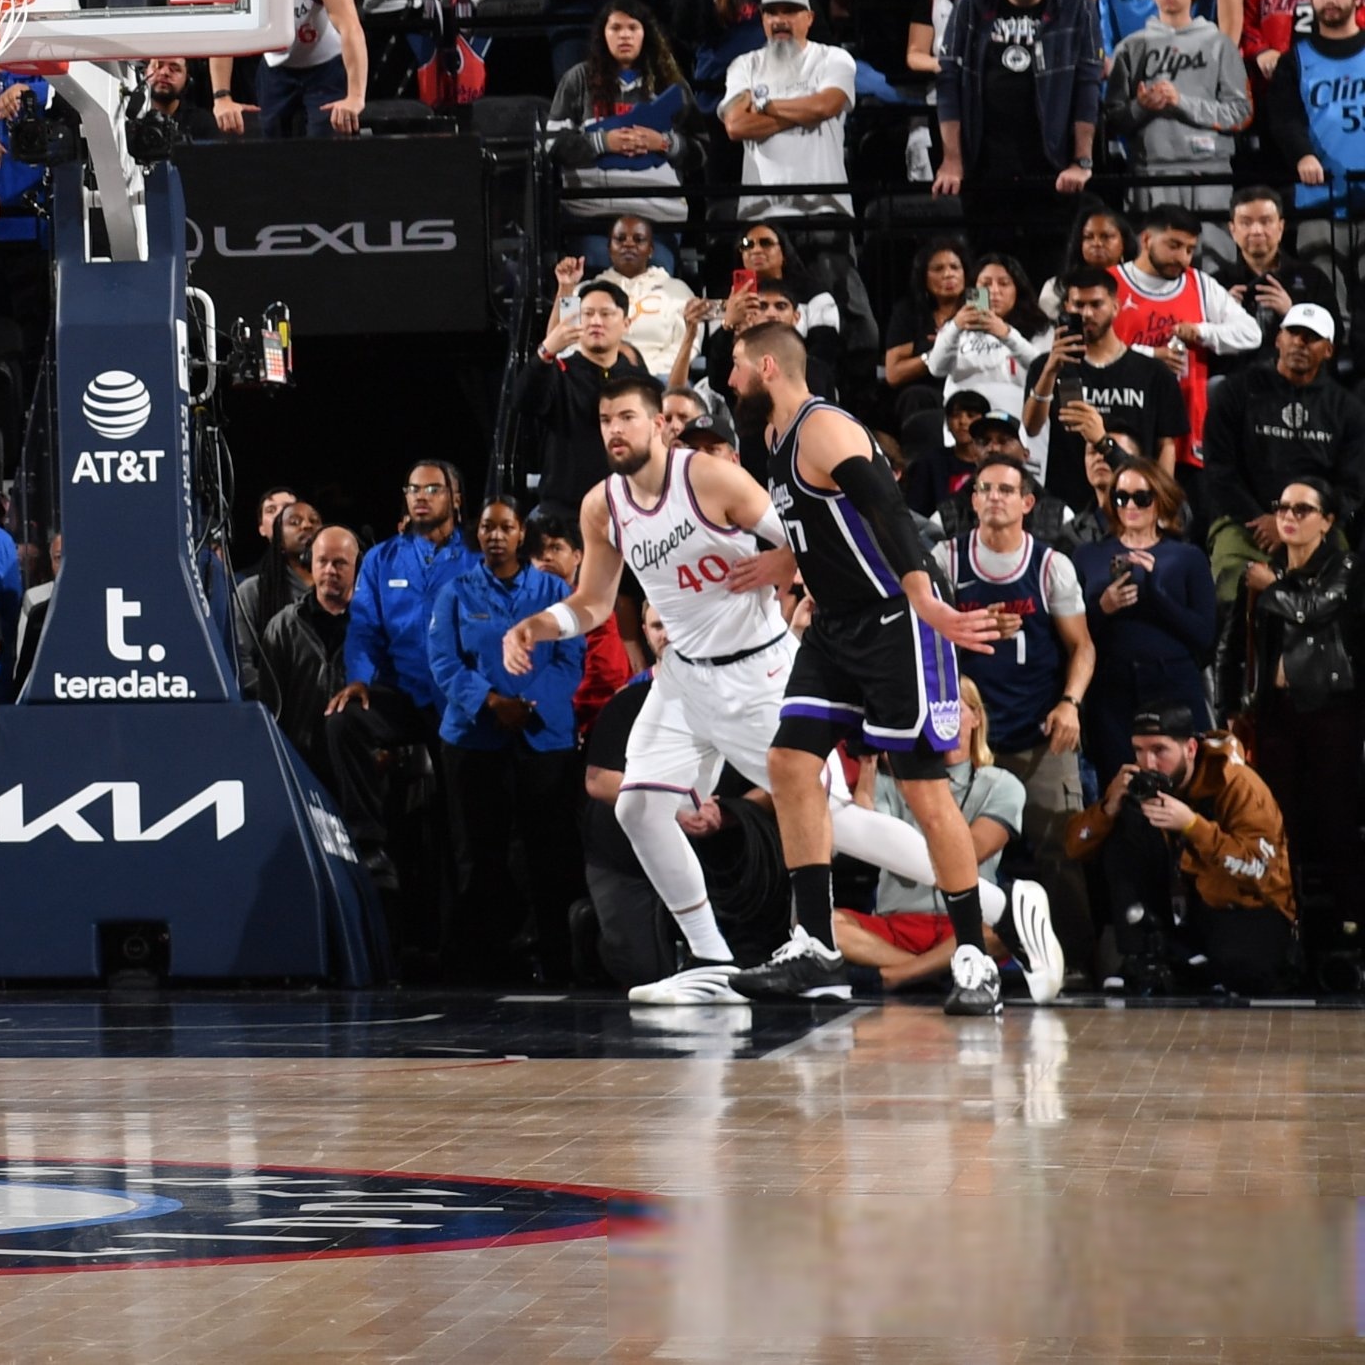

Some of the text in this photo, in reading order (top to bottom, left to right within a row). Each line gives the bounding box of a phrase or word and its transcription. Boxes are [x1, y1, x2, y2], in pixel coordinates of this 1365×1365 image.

[1293, 2, 1313, 33] 2
[1141, 46, 1208, 83] Clips
[212, 218, 458, 257] LEXUS
[1083, 386, 1145, 410] LMAIN
[72, 449, 165, 484] AT&T
[631, 517, 695, 571] Clippers
[676, 546, 730, 594] 40
[53, 670, 197, 700] teradata.
